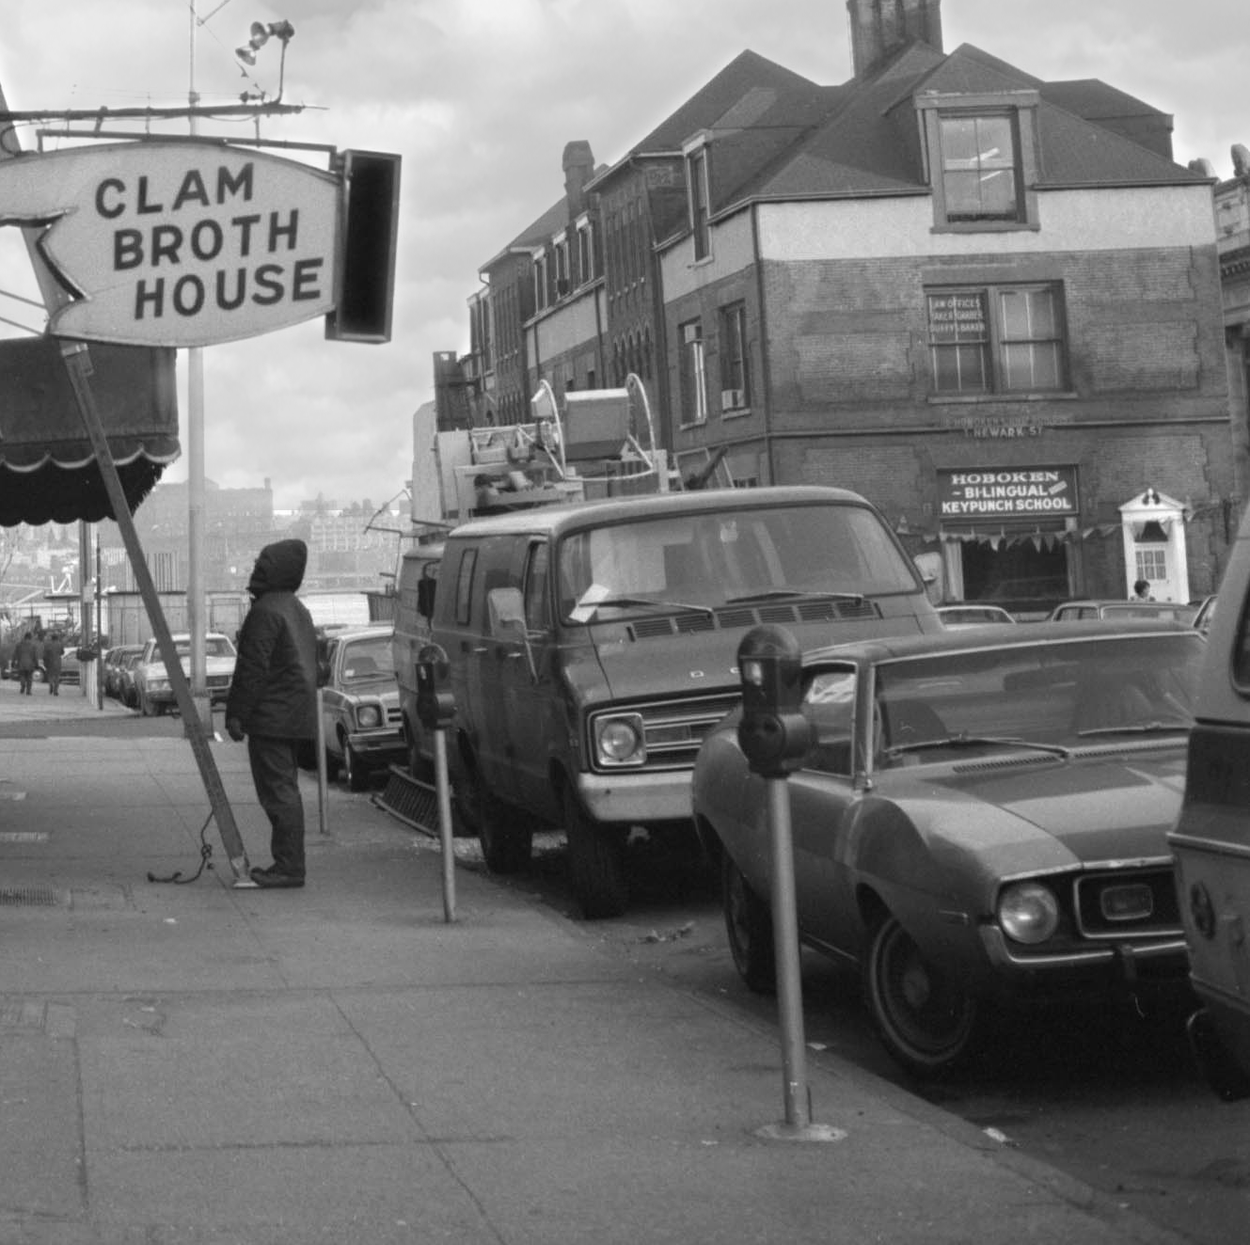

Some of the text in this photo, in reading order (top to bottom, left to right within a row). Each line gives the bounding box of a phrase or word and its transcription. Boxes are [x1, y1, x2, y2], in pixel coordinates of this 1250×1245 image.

[95, 162, 255, 219] CLAM
[113, 208, 299, 271] BROTH
[135, 257, 324, 321] HOUSE
[973, 426, 1025, 437] NEWARK
[952, 470, 1059, 485] HOBOKEN
[942, 497, 1071, 513] KEYPUNCH SCHOOL
